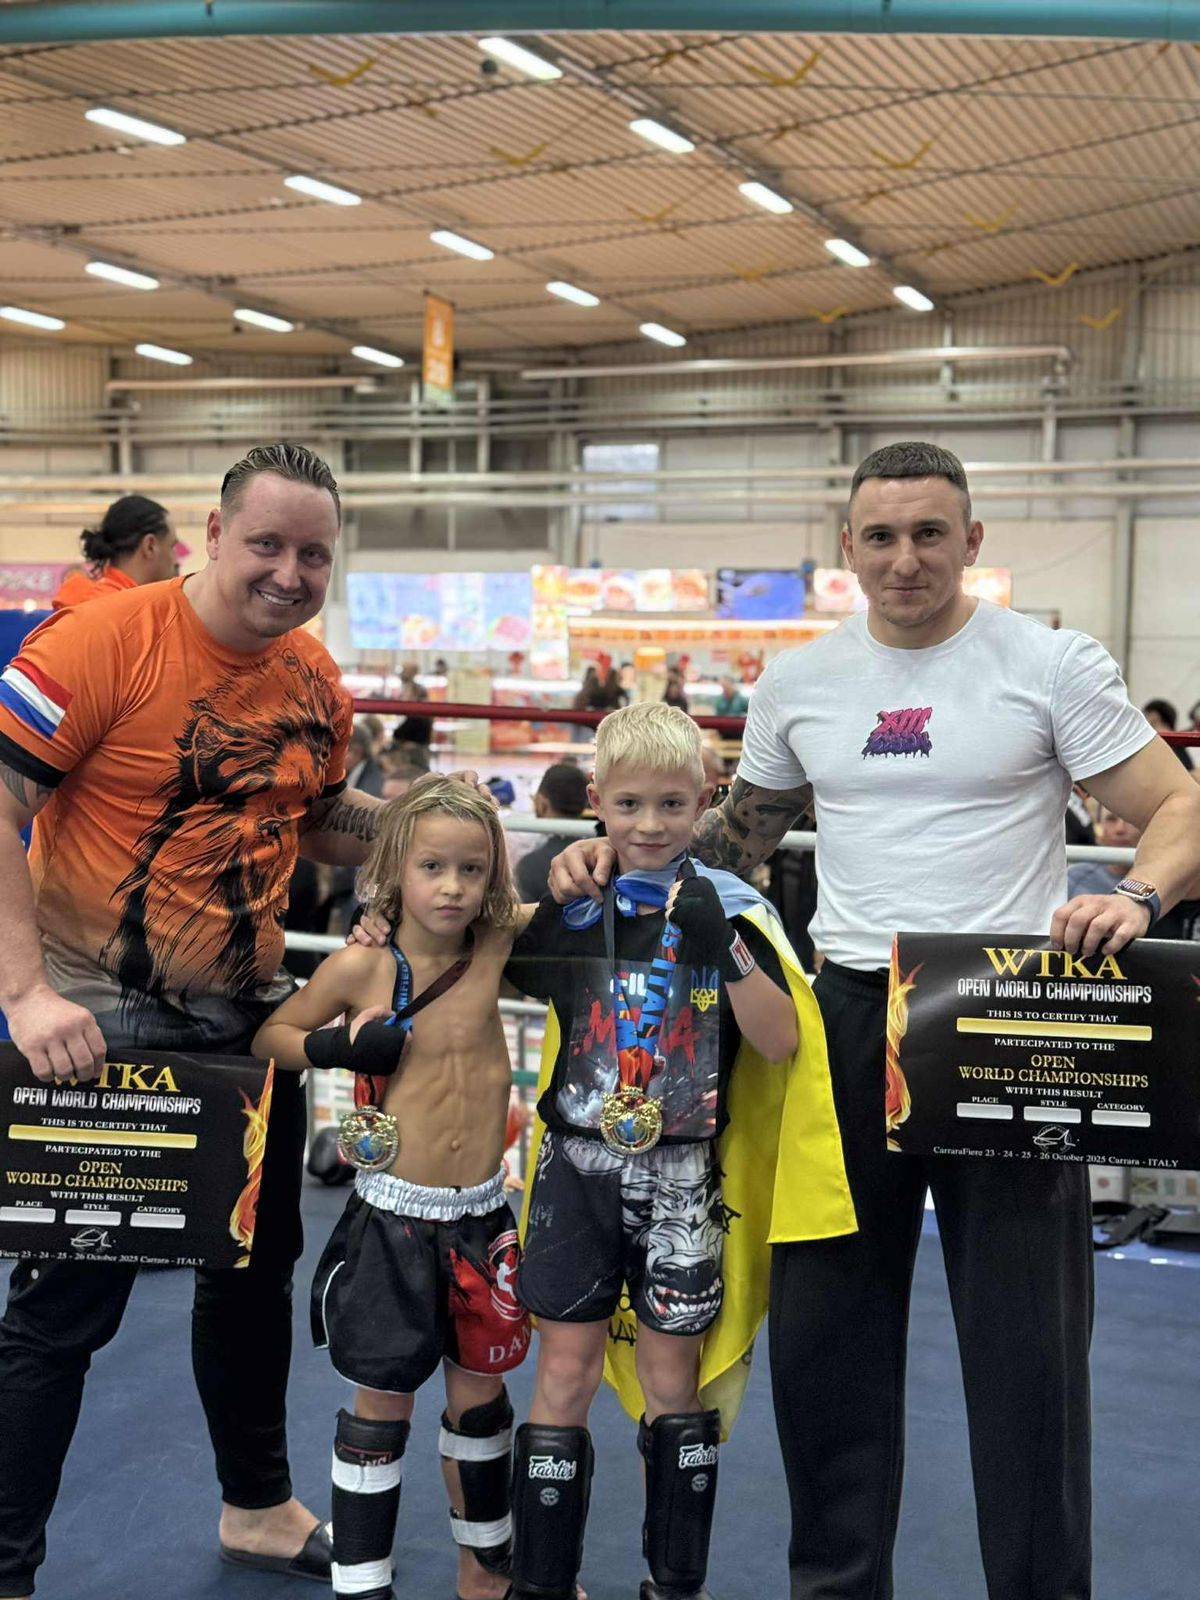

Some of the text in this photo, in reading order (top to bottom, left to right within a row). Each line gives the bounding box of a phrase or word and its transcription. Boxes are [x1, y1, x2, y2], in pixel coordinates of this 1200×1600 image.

[982, 947, 1128, 980] WTKA
[957, 978, 1152, 1004] OPEN WORLD CHAMPIONSHIPS
[635, 957, 677, 1056] ITALY
[986, 1009, 1119, 1024] THIS IS TO CERTIFY THAT
[994, 1038, 1116, 1052] PARTECIPATED TO THE
[1030, 1054, 1076, 1069] OPEN
[55, 1063, 182, 1093] TKA
[958, 1065, 1150, 1089] WORLD CHAMPIONSHIPS
[13, 1086, 202, 1115] OPEN WORLD CHAMPIONSHIPS
[1005, 1086, 1104, 1099] WITH THIS RESULT
[971, 1096, 1146, 1112] PLACE STYLE CATEGORY
[41, 1117, 169, 1133] THIS IS TO CERTIFY THAT
[45, 1144, 162, 1159] PARTECIPATED TO THE
[985, 1149, 996, 1157] 23
[1003, 1150, 1014, 1158] 24
[1021, 1151, 1032, 1159] 25
[1040, 1152, 1050, 1160] 26
[1051, 1152, 1084, 1162] October
[1086, 1155, 1106, 1163] 2025
[1108, 1156, 1140, 1165] Carrara
[1148, 1158, 1179, 1168] ITALY
[79, 1160, 122, 1175] OPEN
[6, 1171, 189, 1193] WORLD CHAMPIONSHIPS
[50, 1190, 145, 1203] WITH THIS RESULT
[15, 1200, 182, 1215] PLACE STYLE CATEGORY
[176, 1257, 206, 1266] ITALY
